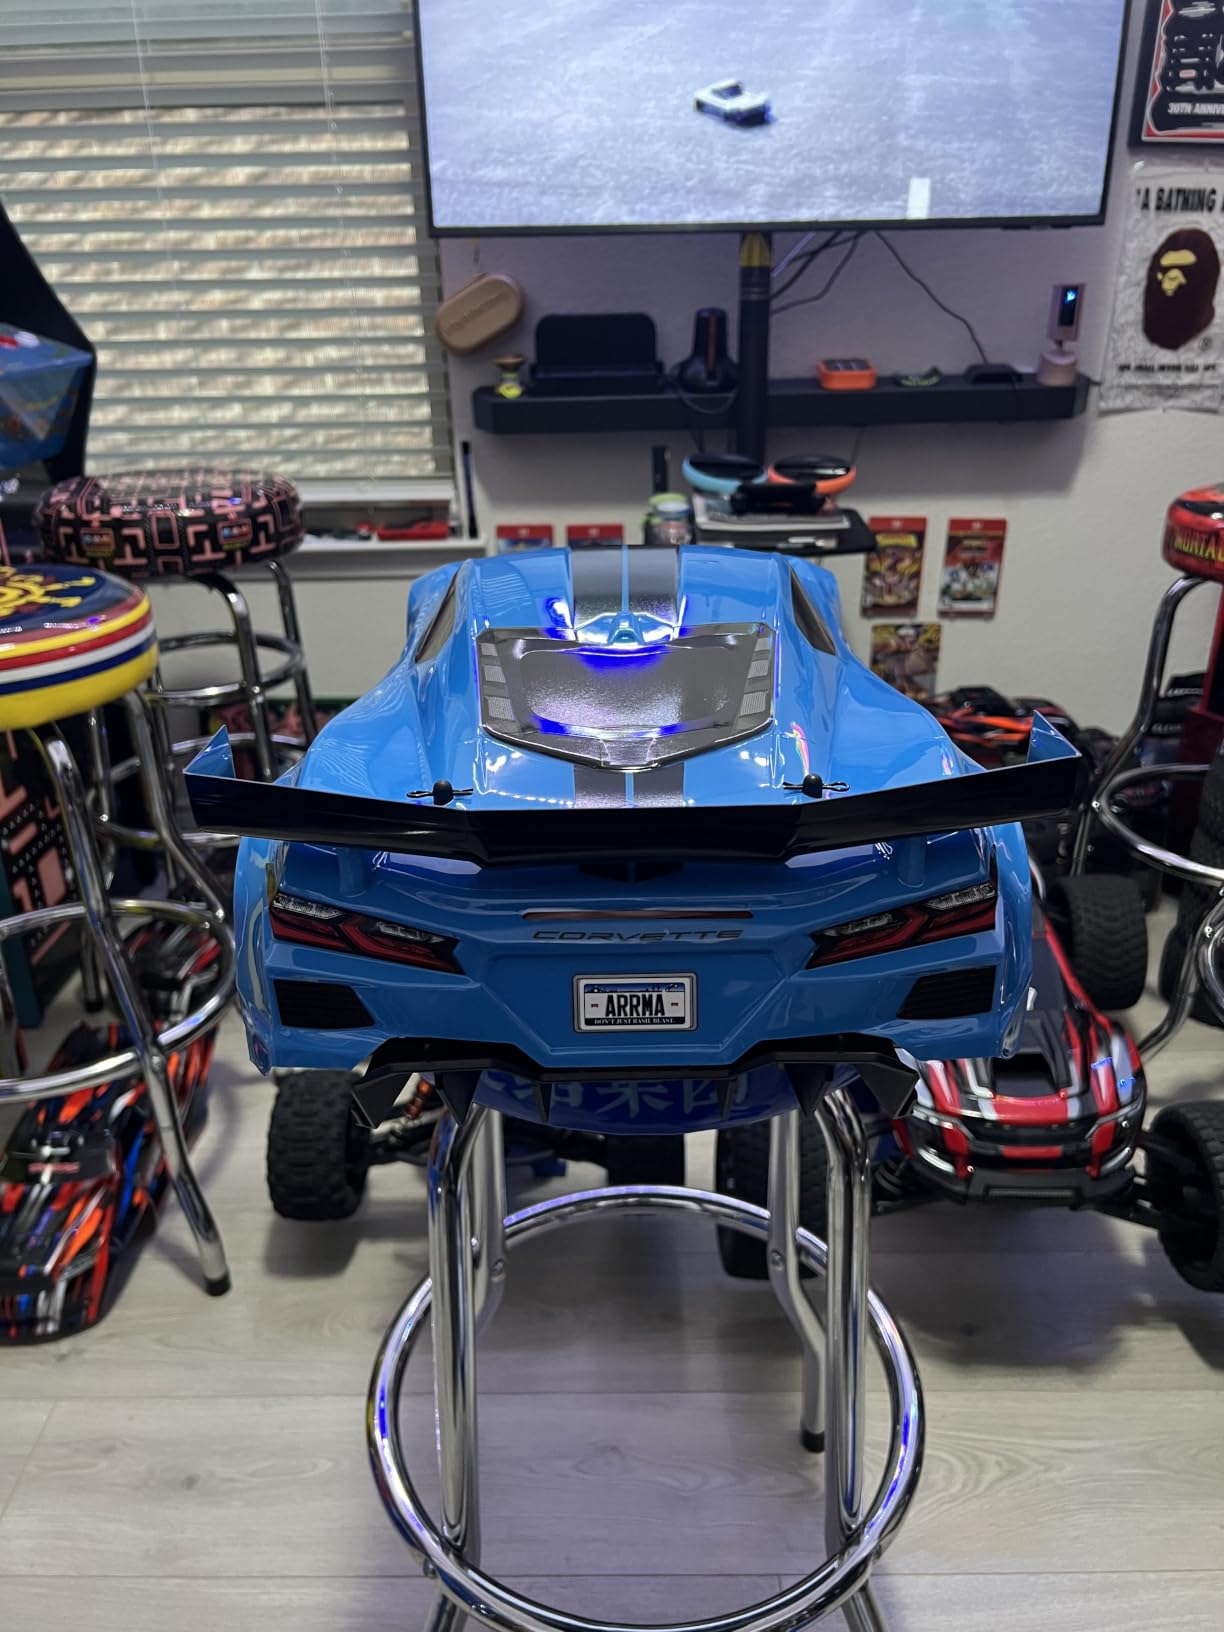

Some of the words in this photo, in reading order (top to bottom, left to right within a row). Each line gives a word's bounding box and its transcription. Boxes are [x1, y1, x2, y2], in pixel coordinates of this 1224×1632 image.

[1155, 187, 1217, 213] BATHING
[533, 929, 743, 942] CORVETTE
[605, 993, 666, 1017] ARRMA
